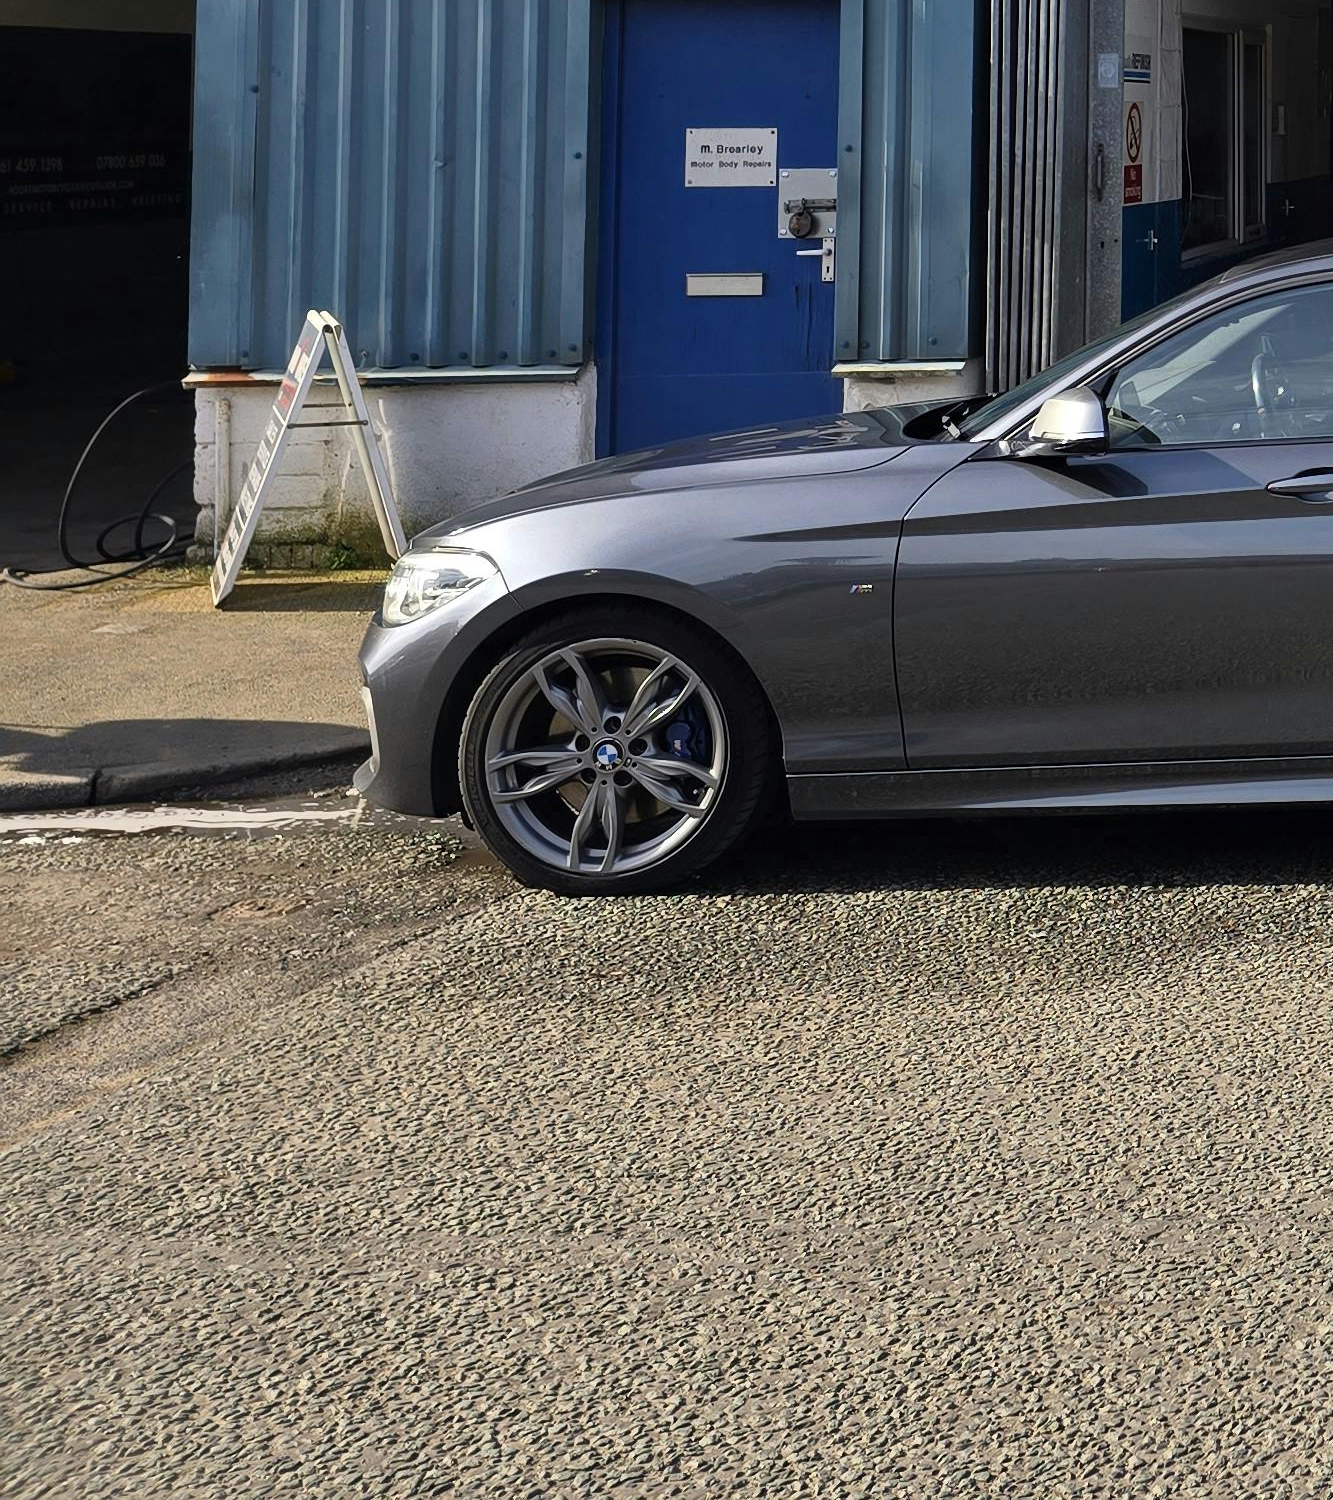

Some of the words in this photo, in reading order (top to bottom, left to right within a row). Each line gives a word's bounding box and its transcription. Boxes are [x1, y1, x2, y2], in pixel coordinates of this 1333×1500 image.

[717, 144, 764, 155] Brearley
[719, 160, 739, 169] Body
[743, 160, 772, 169] Repairs
